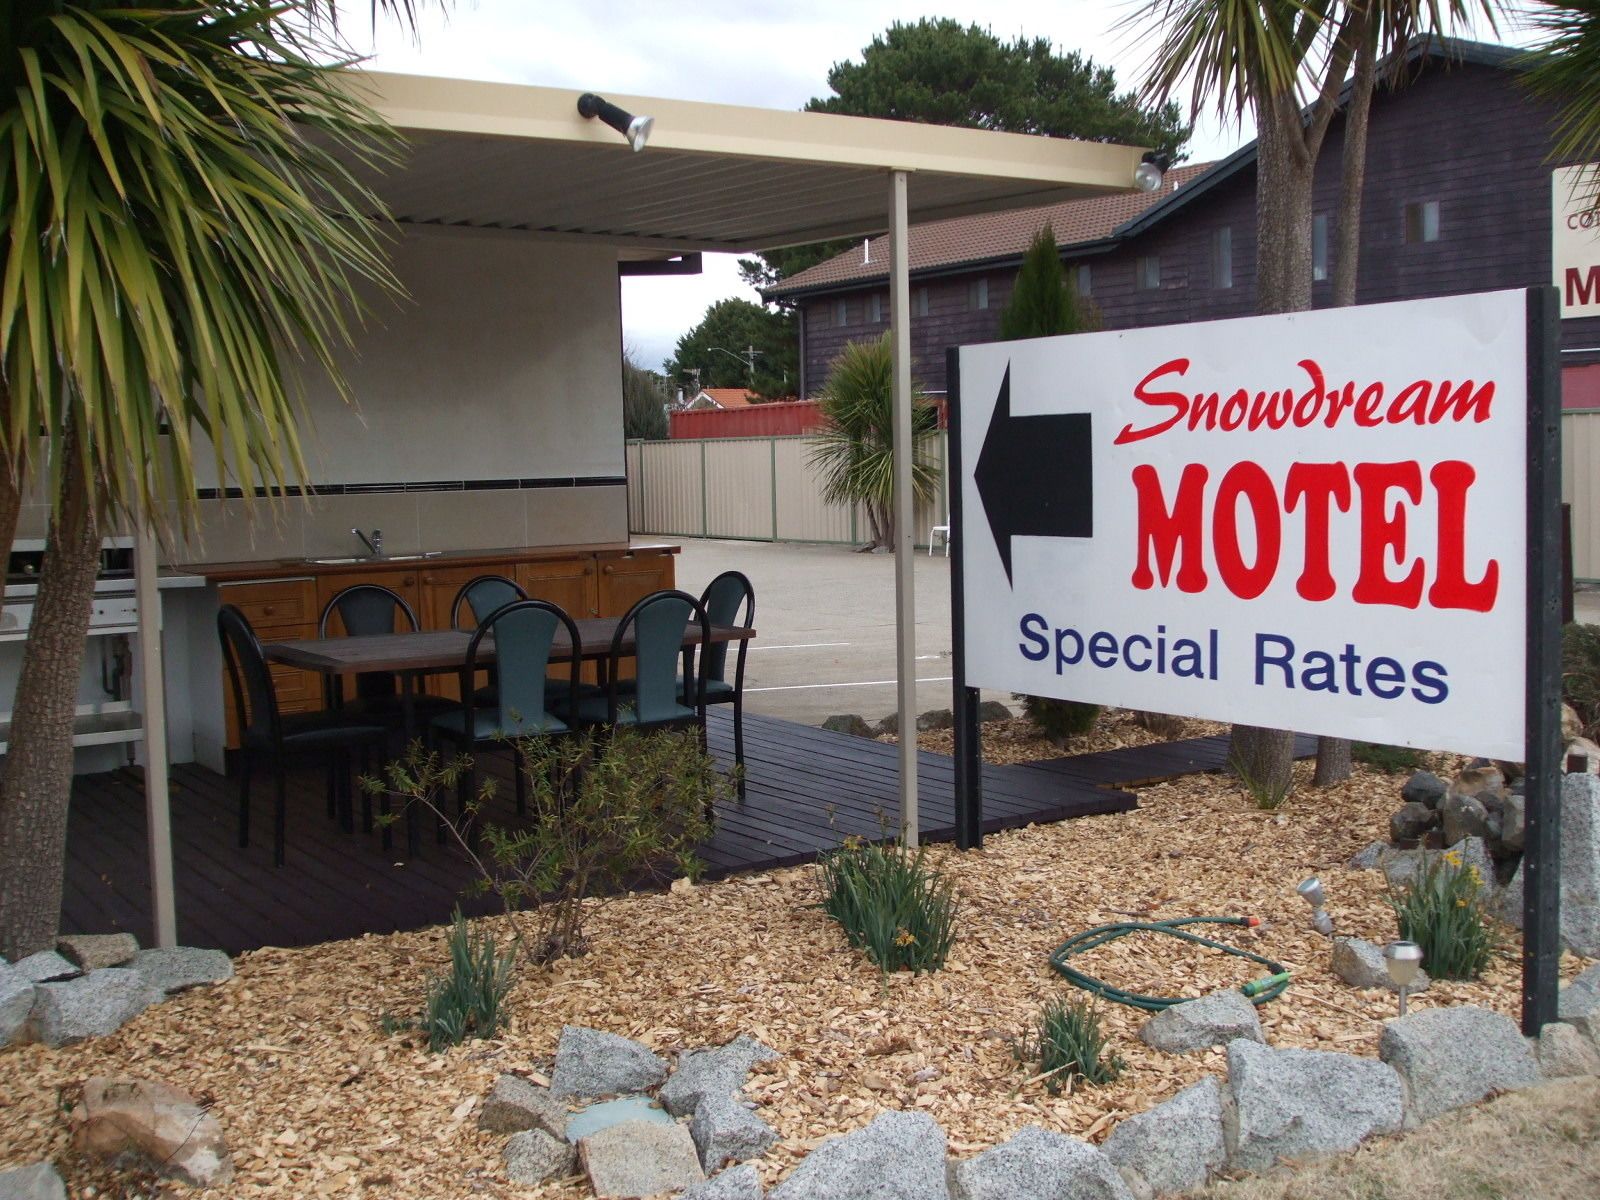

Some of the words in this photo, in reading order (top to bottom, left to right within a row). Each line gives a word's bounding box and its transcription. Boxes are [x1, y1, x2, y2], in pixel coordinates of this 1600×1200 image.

[1113, 357, 1497, 446] Snowdream
[1131, 460, 1500, 613] MOTEL
[1019, 613, 1219, 680] Special
[1255, 633, 1450, 705] Rates
